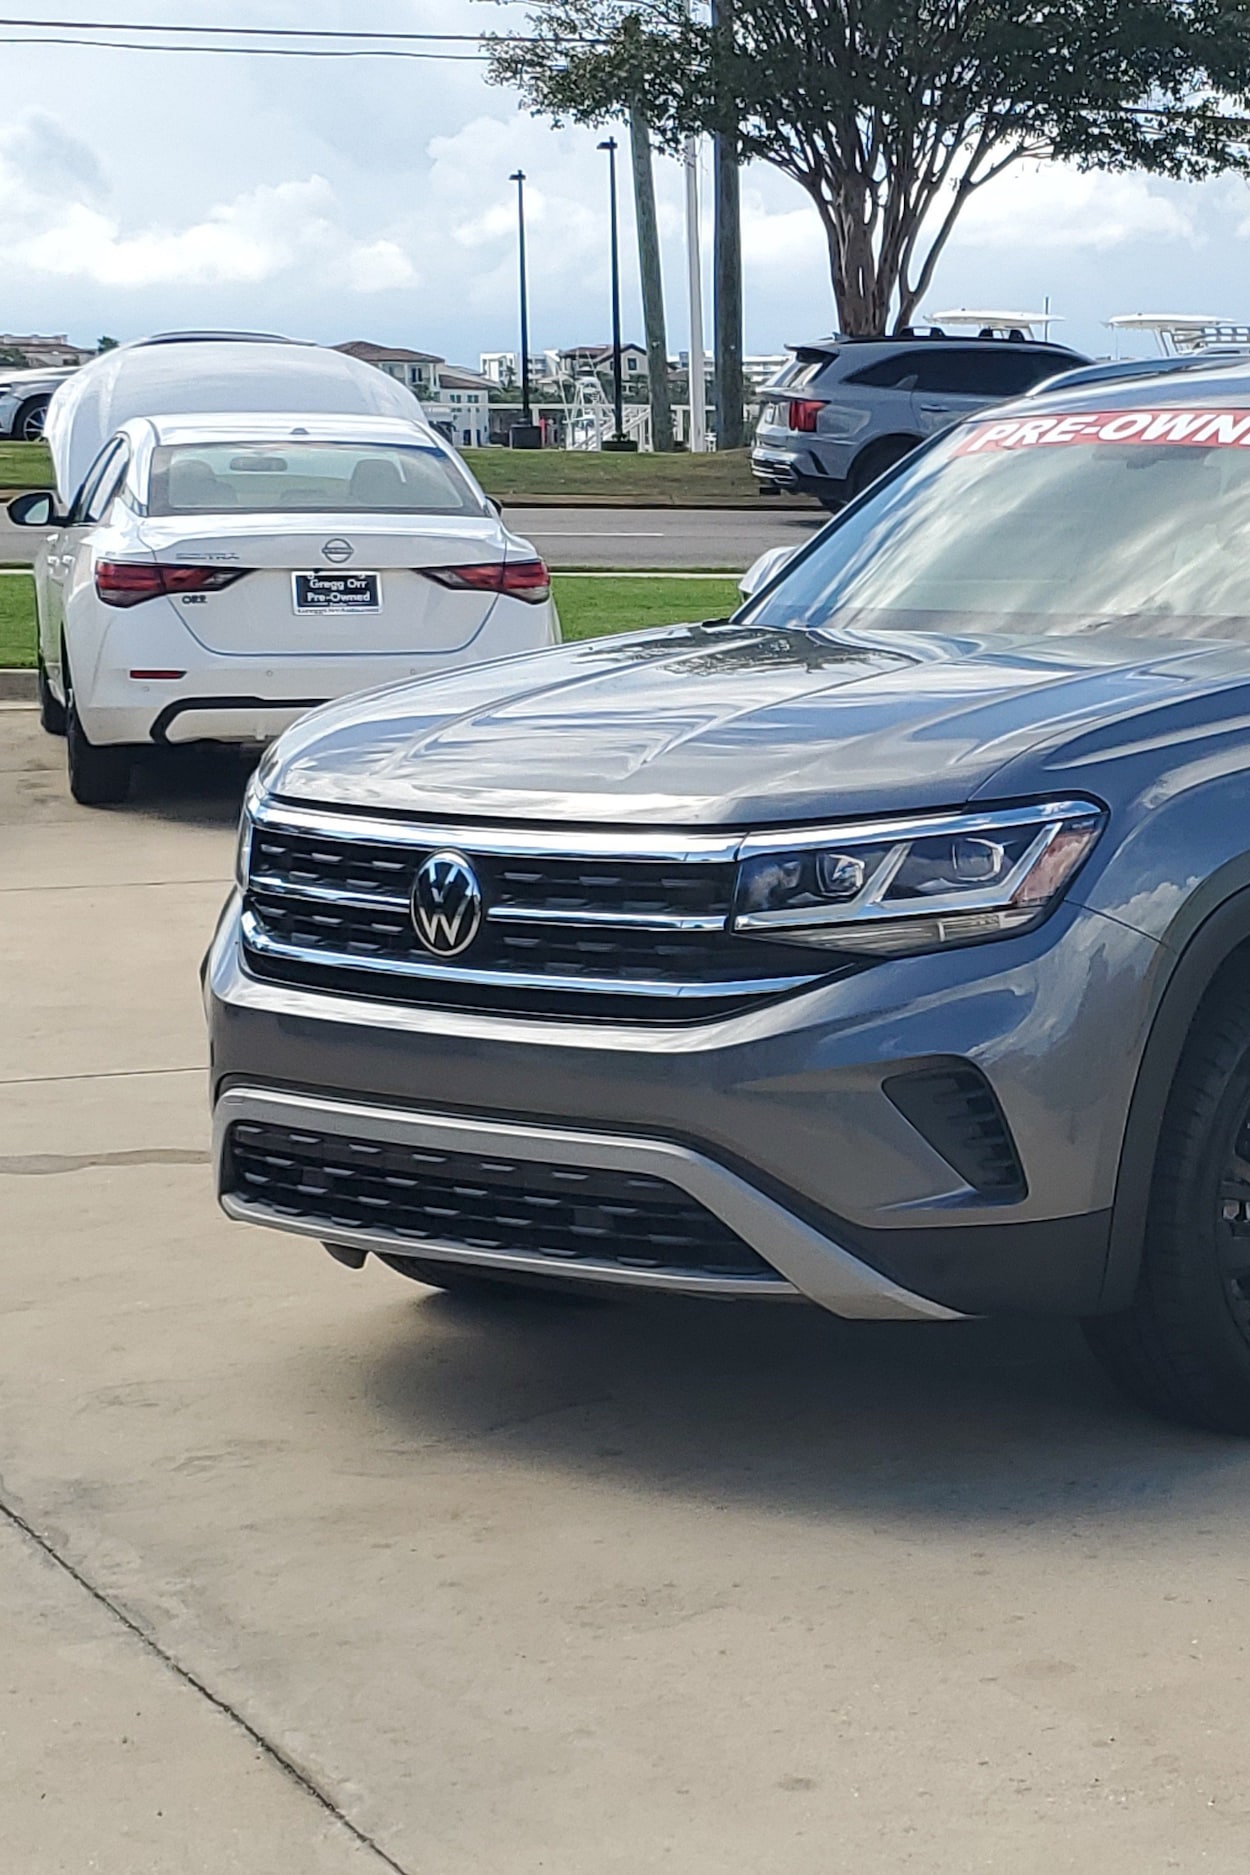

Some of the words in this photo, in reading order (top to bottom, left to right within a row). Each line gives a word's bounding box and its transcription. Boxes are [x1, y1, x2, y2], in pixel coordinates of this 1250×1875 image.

[309, 579, 345, 591] Gregg
[347, 579, 367, 589] Orr
[306, 590, 371, 602] Pre-Owned
